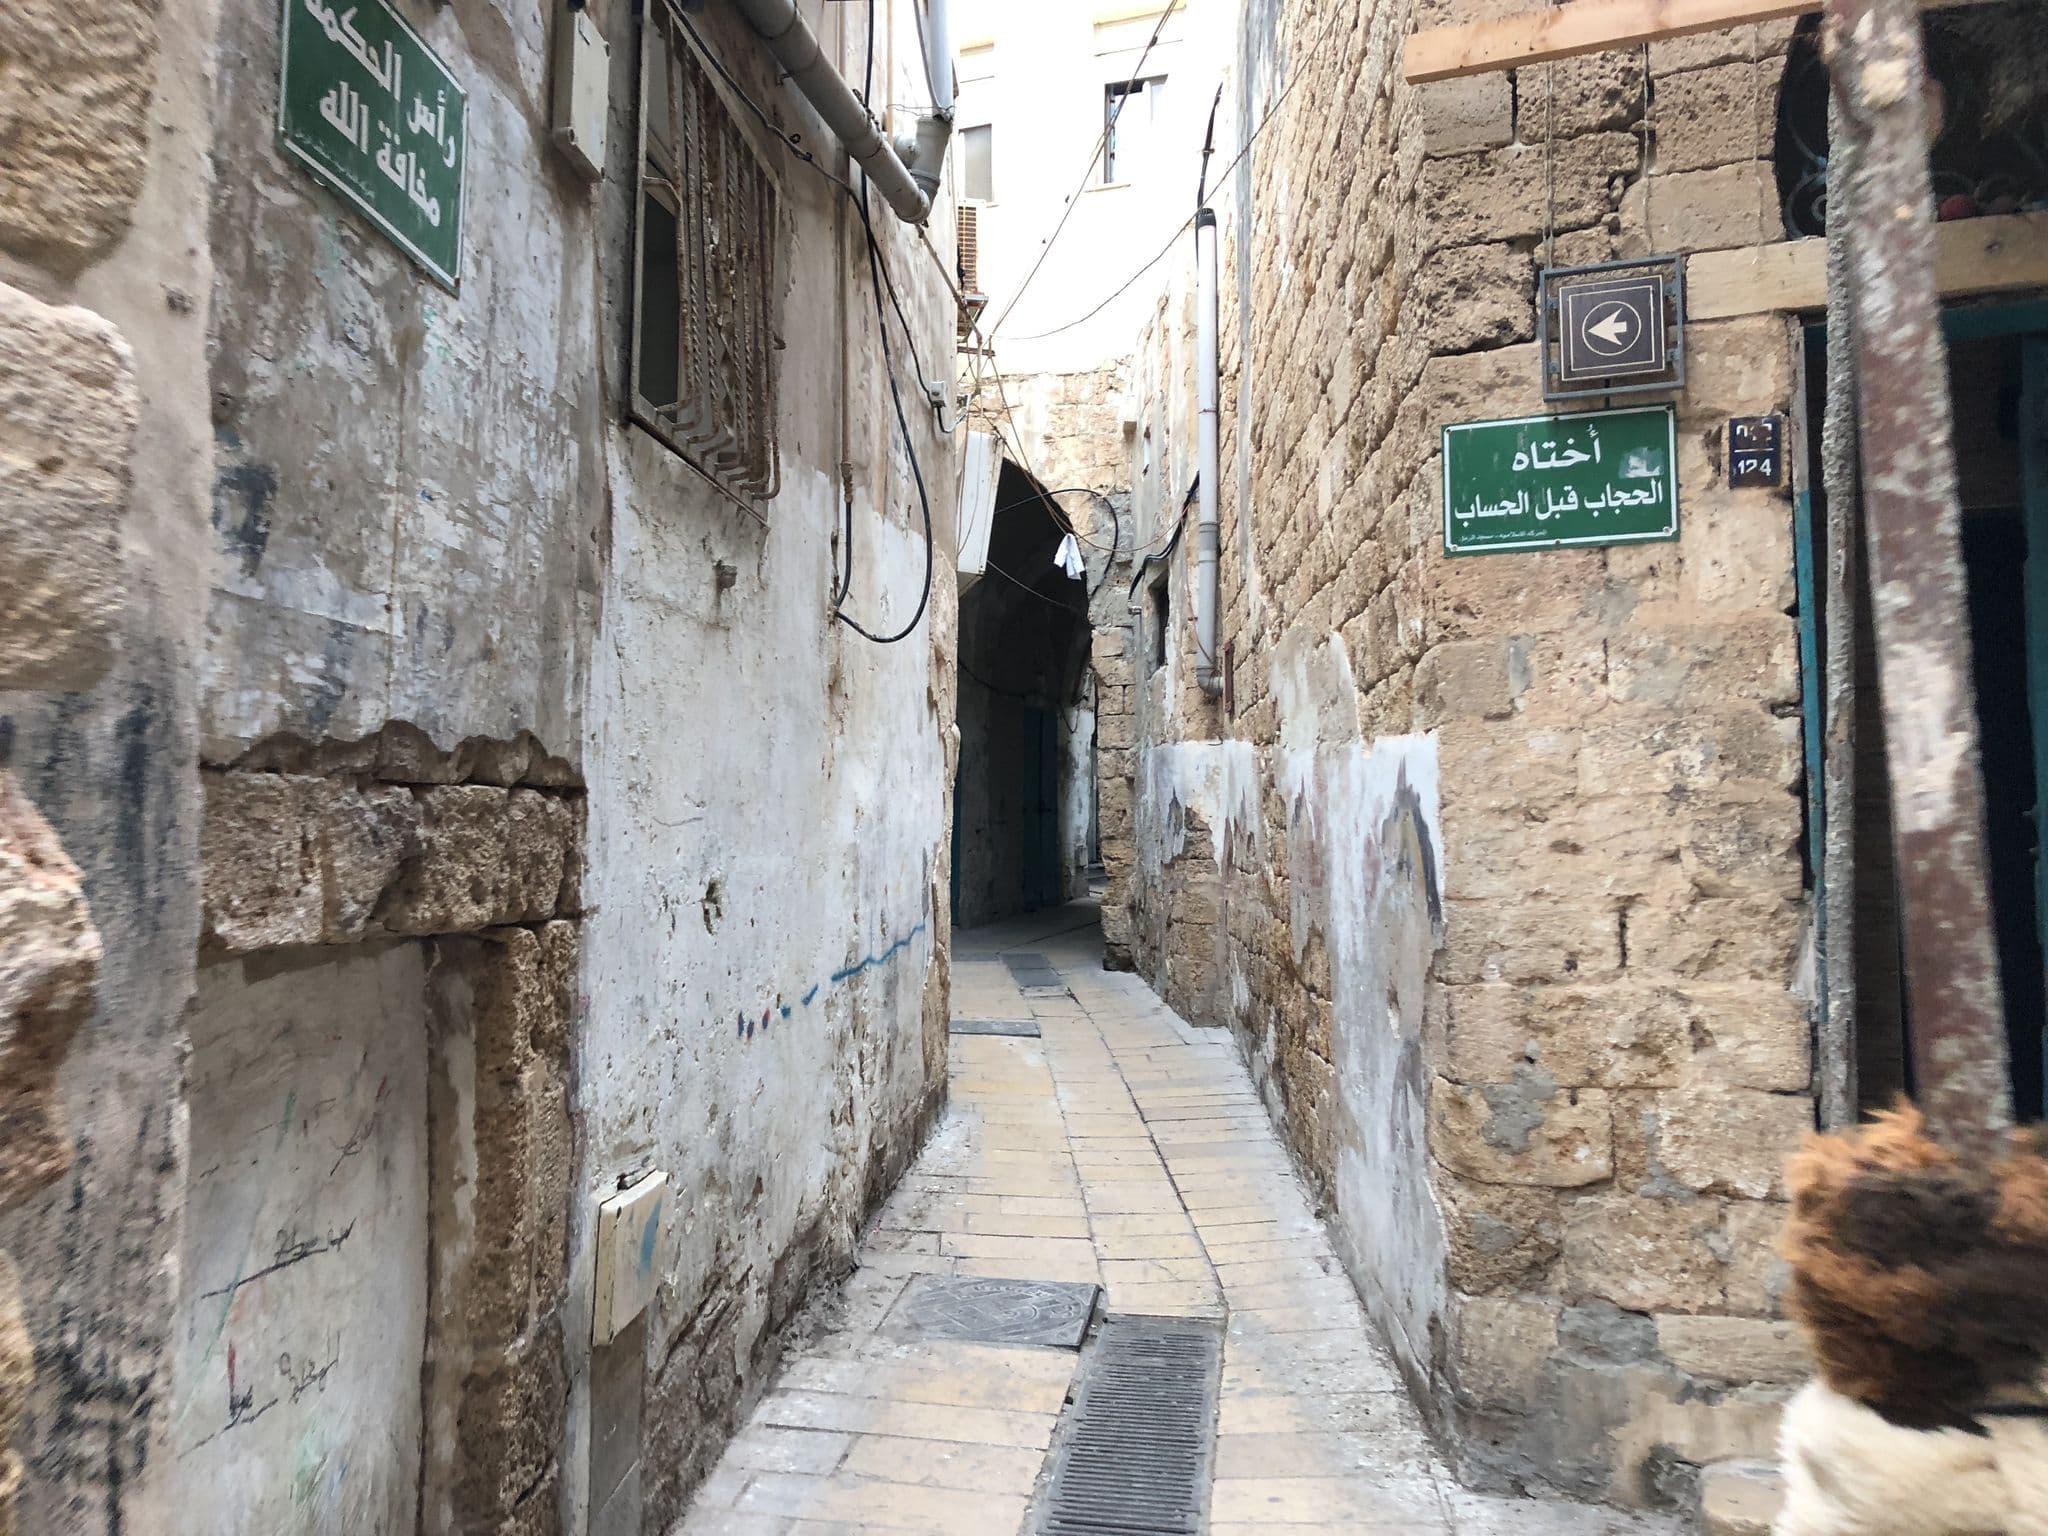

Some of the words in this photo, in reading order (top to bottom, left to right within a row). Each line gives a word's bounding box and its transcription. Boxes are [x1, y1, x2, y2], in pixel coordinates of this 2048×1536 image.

[319, 80, 369, 155] الله
[406, 89, 455, 168] رأس
[376, 120, 440, 226] مخافة
[1737, 458, 1772, 477] 124
[1454, 490, 1529, 528] الحساب
[1535, 485, 1579, 520] قبل
[1584, 478, 1663, 518] الحجاب
